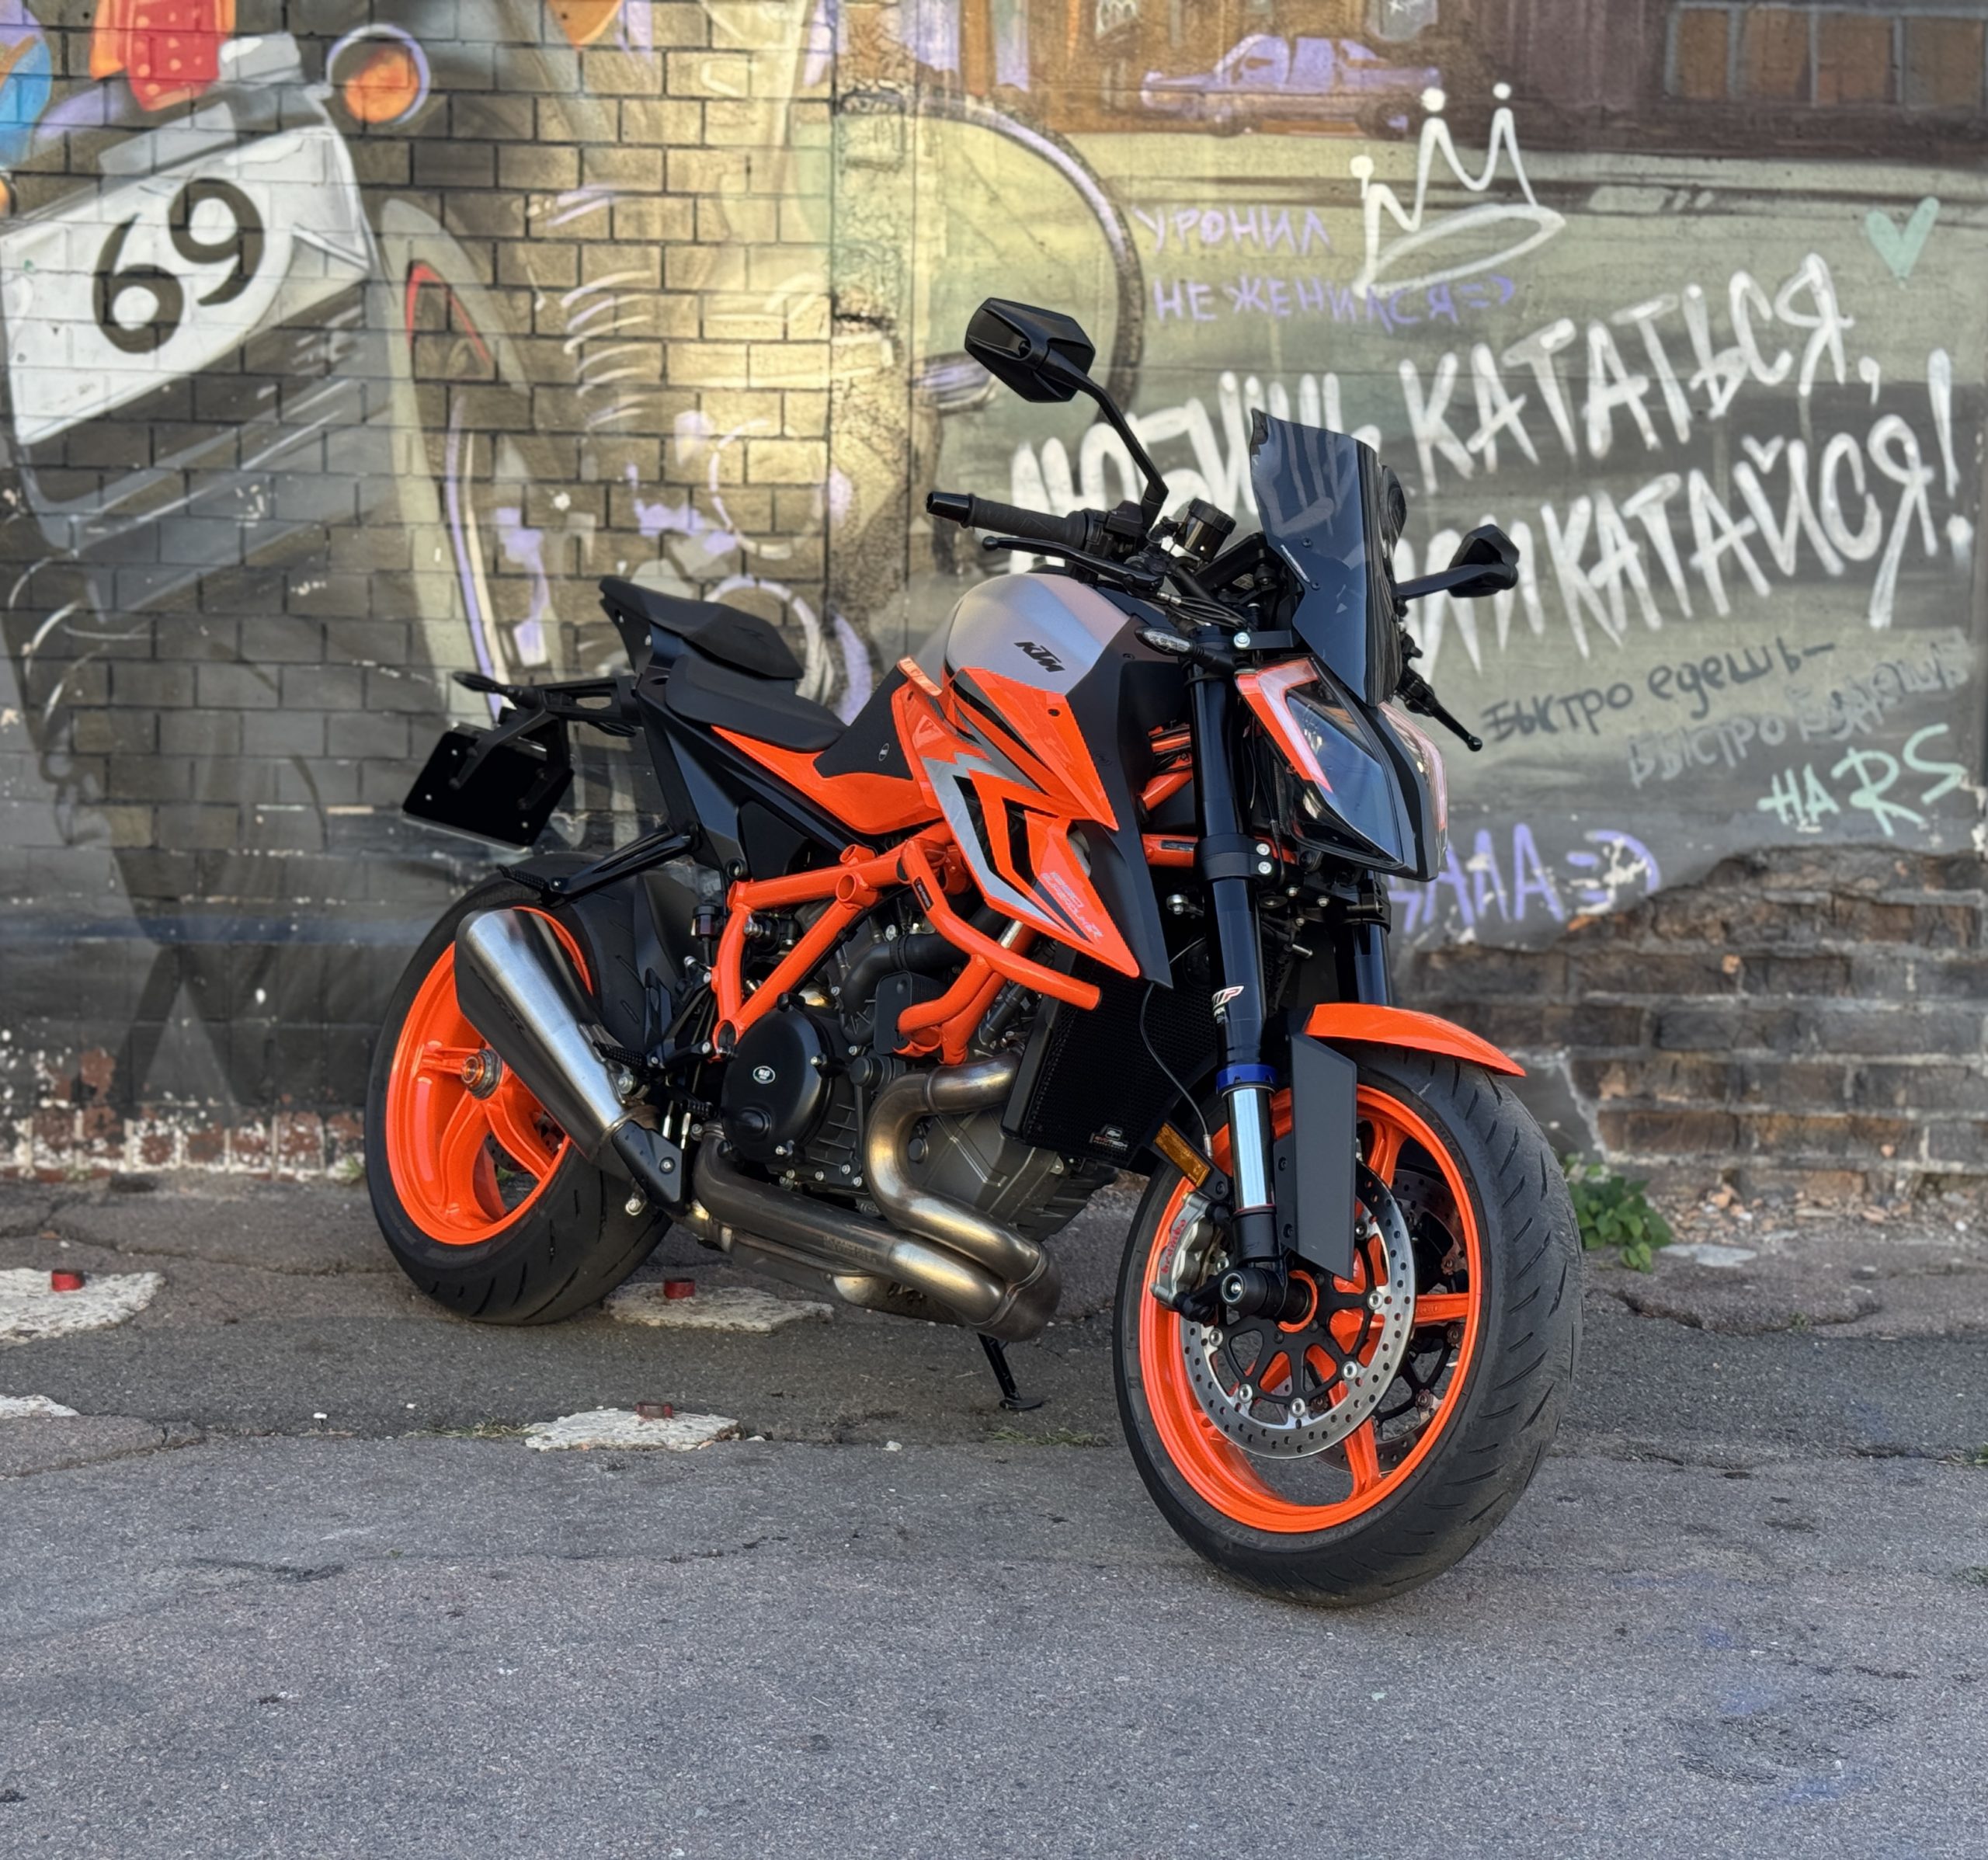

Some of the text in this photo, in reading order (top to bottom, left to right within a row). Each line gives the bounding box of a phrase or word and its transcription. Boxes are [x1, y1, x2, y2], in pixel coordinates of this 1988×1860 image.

[1131, 204, 1335, 256] УРОНИЛ
[92, 177, 266, 355] 69
[1152, 276, 1218, 322] НЕ
[1399, 252, 1880, 495] КАТАТЬСЯ,
[1013, 641, 1065, 673] KTM
